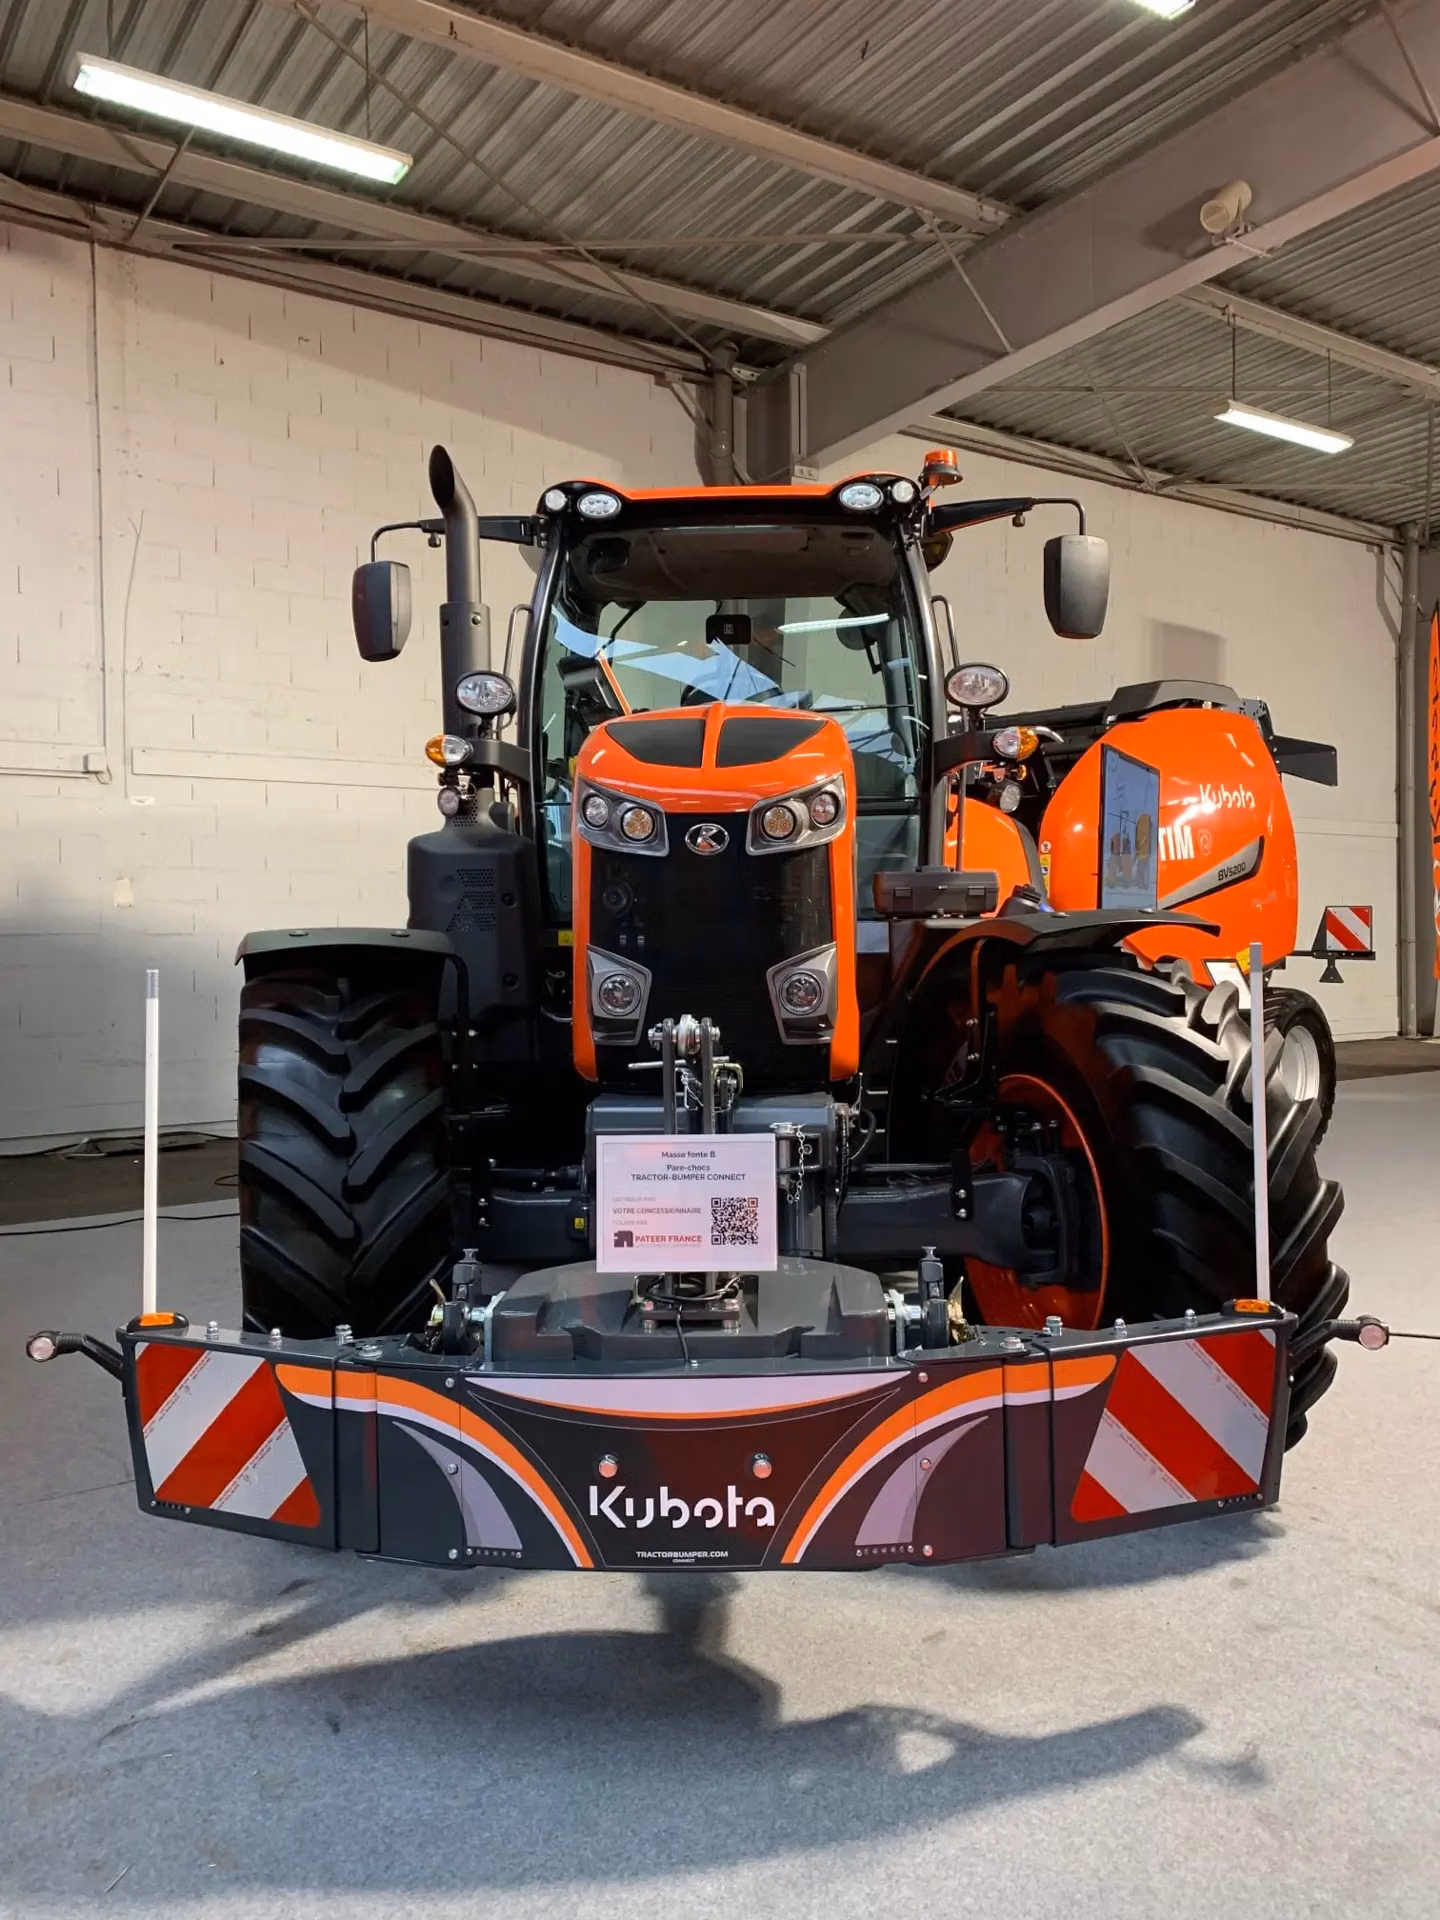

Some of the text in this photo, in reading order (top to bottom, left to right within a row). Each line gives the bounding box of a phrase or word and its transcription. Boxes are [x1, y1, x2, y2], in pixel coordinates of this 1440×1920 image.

[1199, 783, 1256, 809] Kubota
[1158, 825, 1195, 861] TIM
[631, 1173, 746, 1181] TRACTOR-BUMPER CONNECT
[666, 1164, 711, 1172] Pare-chocs
[589, 1485, 775, 1528] Kubota
